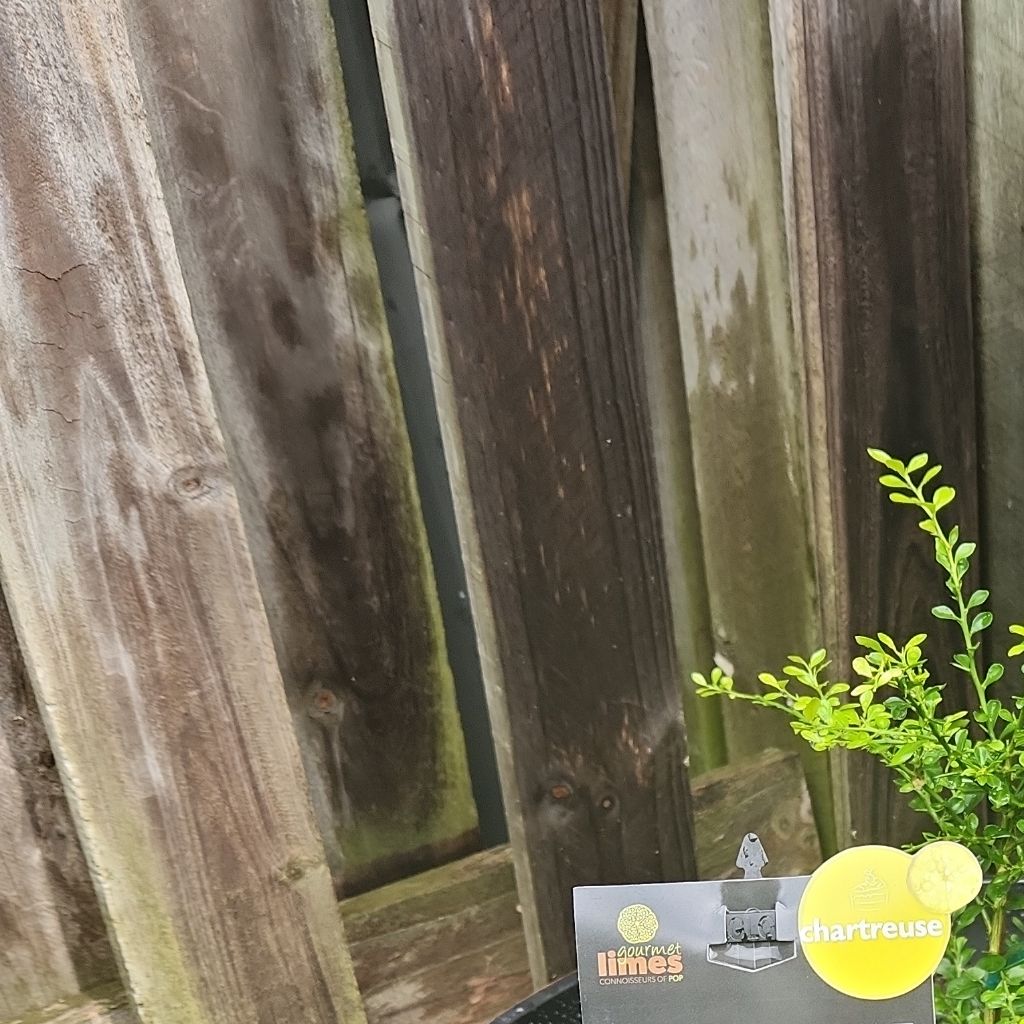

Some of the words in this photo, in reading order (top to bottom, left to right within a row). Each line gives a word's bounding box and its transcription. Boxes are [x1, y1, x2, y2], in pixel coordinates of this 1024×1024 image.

[801, 917, 945, 943] chartreuse
[597, 950, 683, 977] limes
[617, 942, 682, 965] gourmet
[599, 976, 656, 986] CONNOISSEURS
[657, 975, 667, 983] OF
[668, 974, 684, 983] POP
